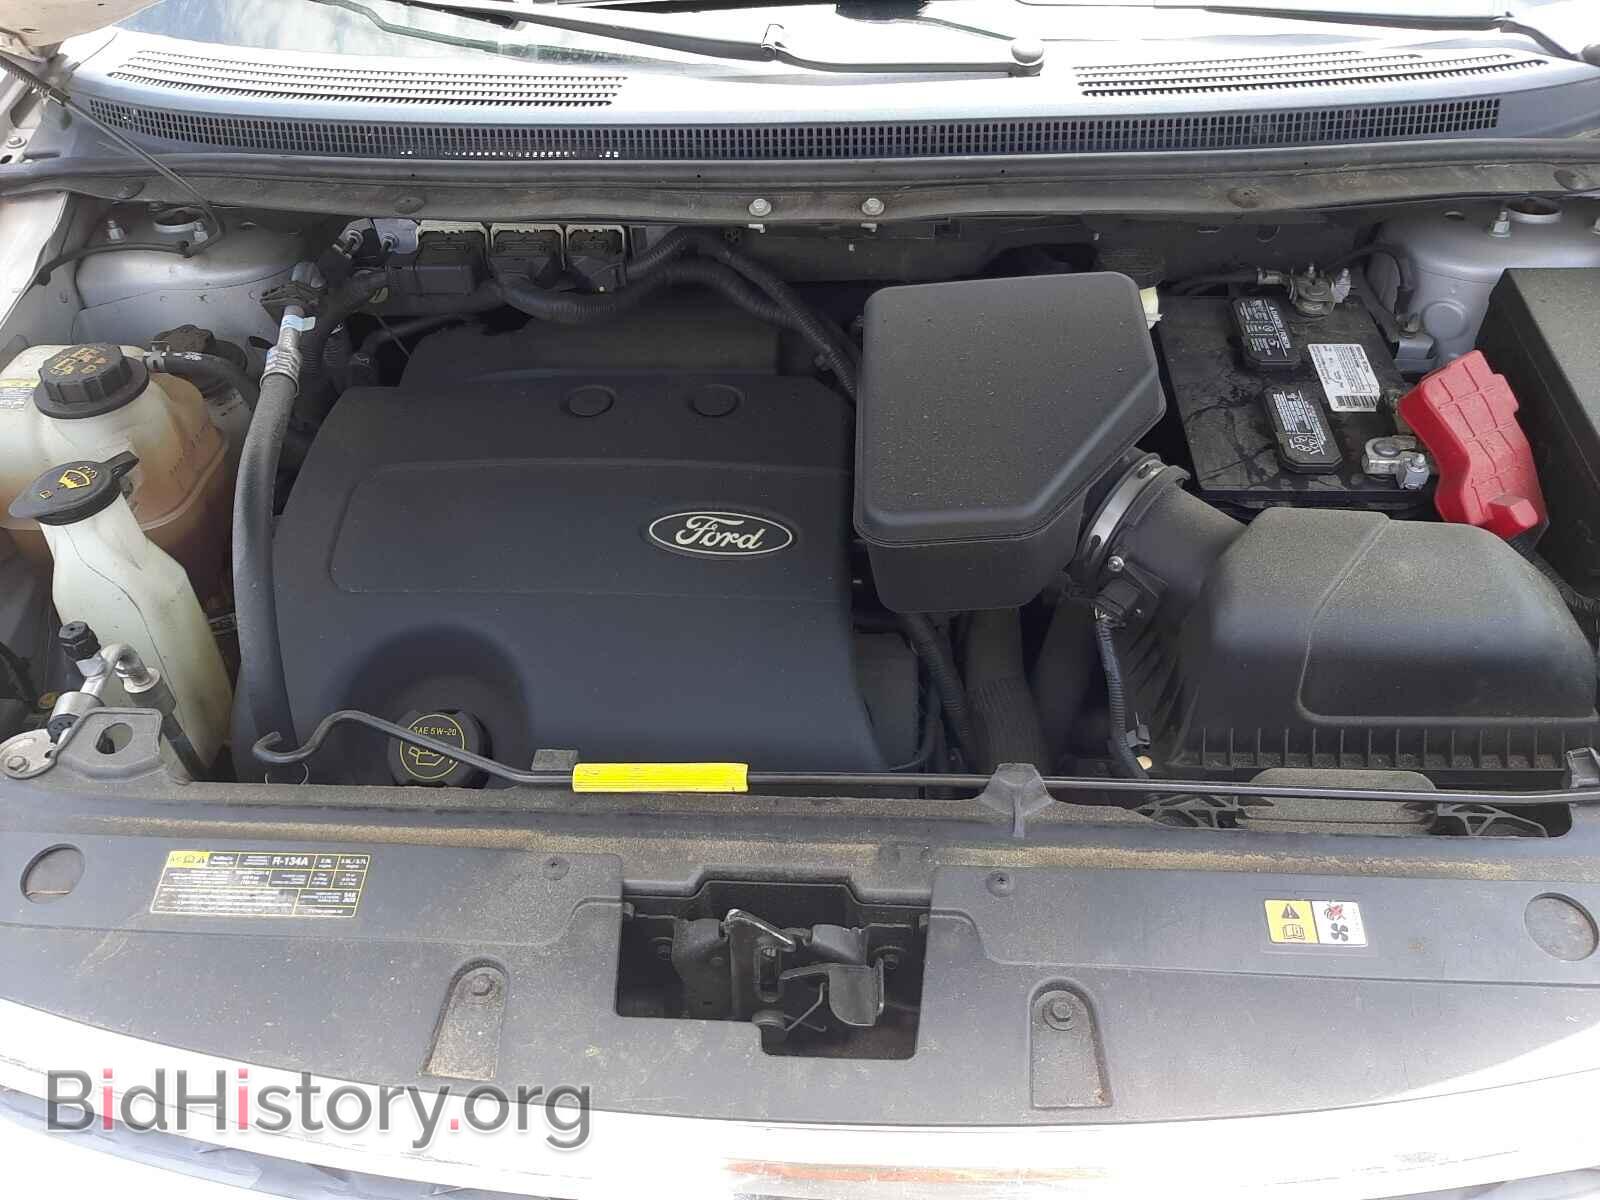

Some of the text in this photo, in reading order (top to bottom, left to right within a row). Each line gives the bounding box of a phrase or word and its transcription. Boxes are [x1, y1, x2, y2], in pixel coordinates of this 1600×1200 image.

[675, 515, 766, 549] Ford
[430, 727, 457, 736] 5W-20
[272, 856, 308, 866] R-134A
